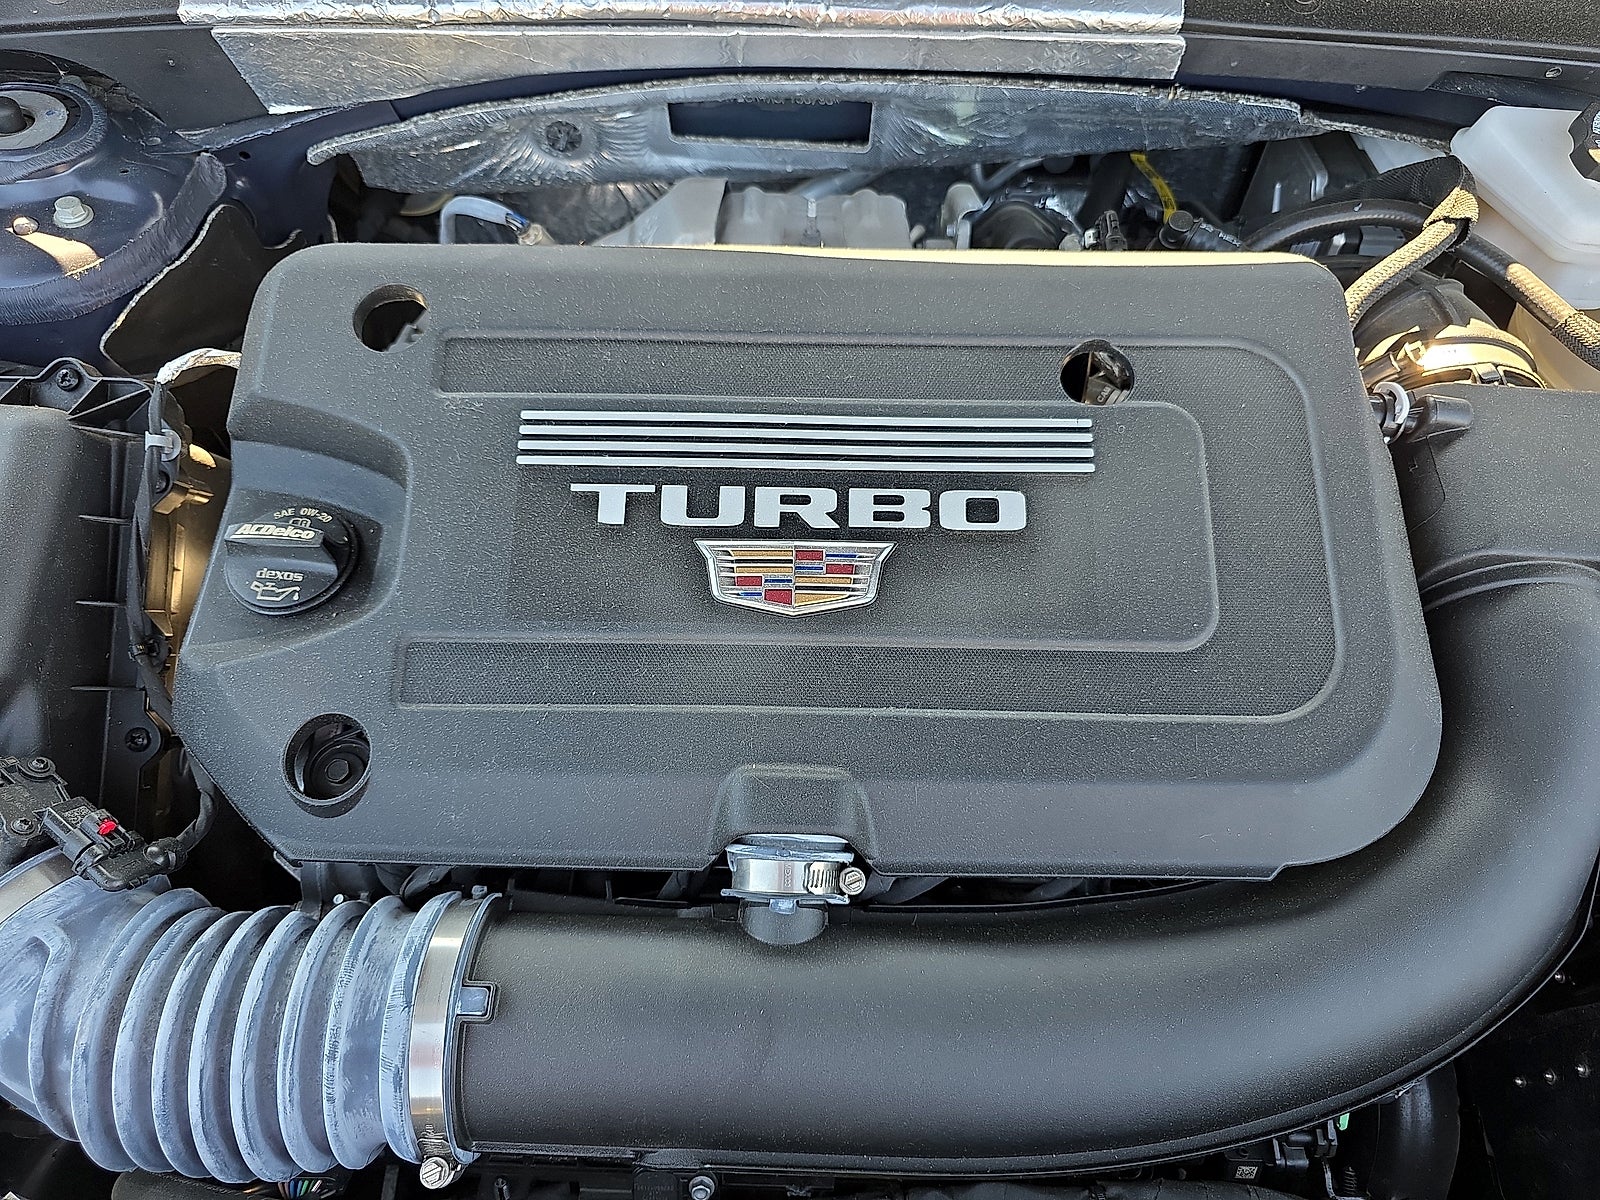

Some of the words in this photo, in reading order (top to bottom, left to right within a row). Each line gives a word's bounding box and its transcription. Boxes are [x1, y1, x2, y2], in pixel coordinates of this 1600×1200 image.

[273, 508, 296, 520] SAE
[300, 507, 333, 523] 0W-20
[570, 483, 1027, 532] TURBO
[234, 523, 316, 540] ACDelco
[256, 568, 304, 582] dexos
